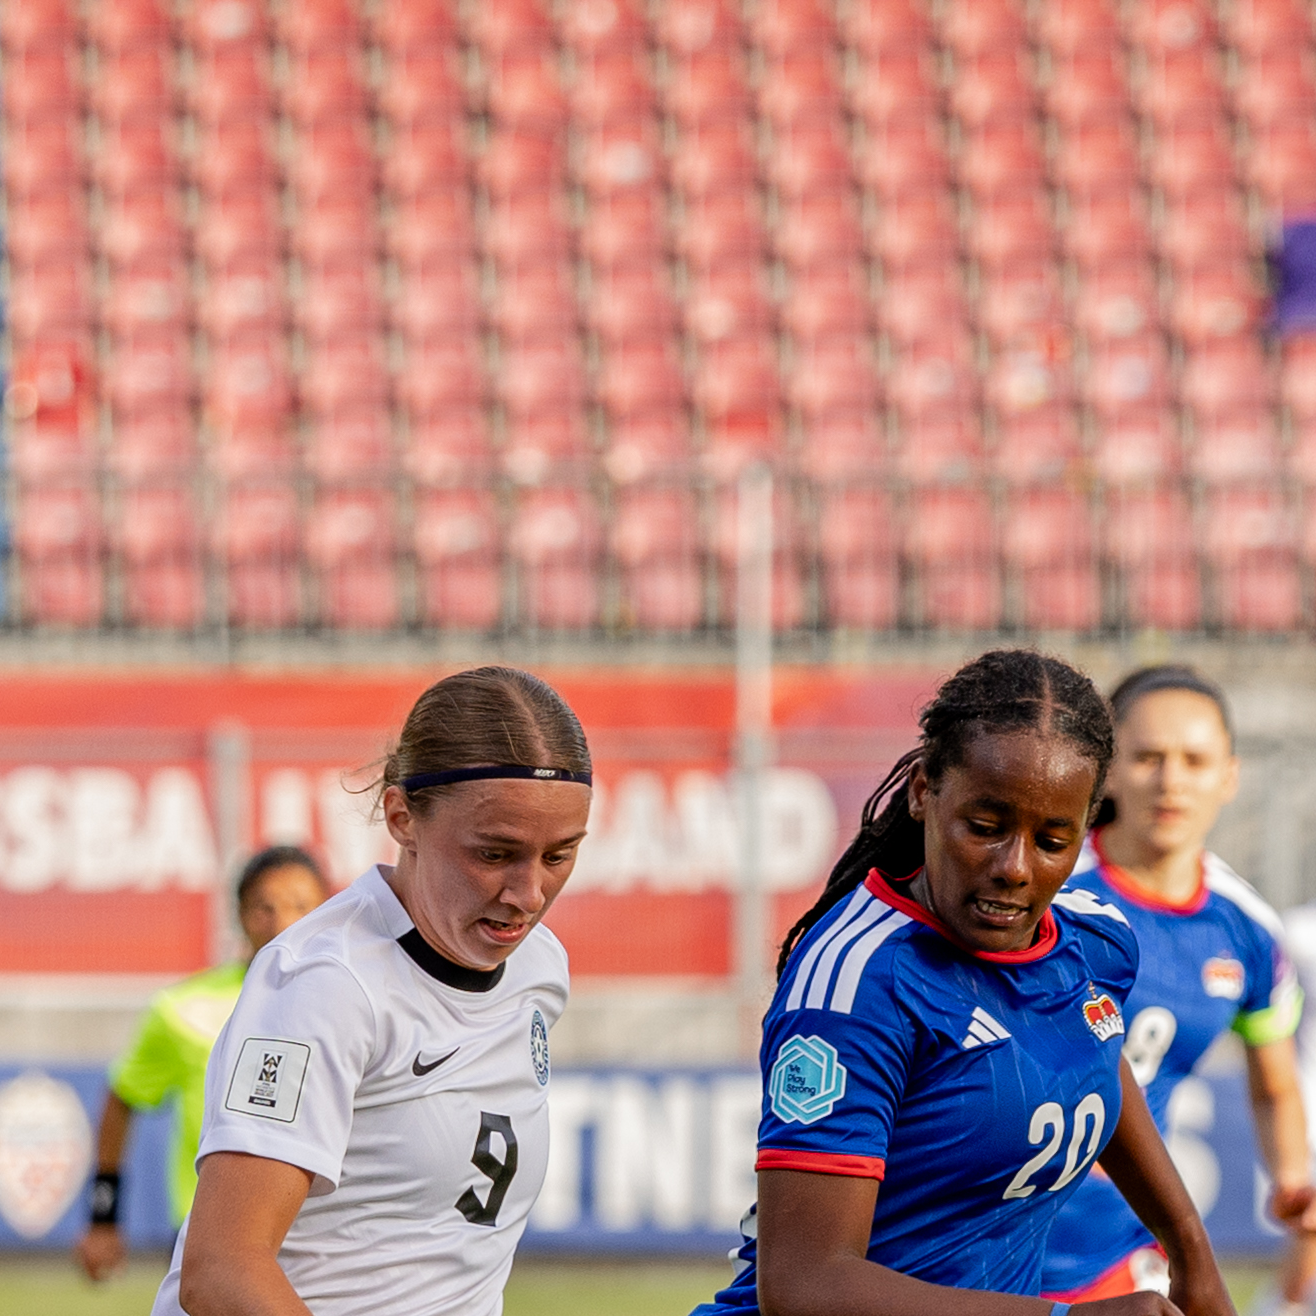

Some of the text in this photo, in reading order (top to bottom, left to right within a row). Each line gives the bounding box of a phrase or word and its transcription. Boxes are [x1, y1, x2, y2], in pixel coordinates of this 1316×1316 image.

[786, 1083, 817, 1097] Strong
[787, 1073, 806, 1086] Play
[453, 1110, 519, 1228] 9
[1002, 1092, 1106, 1200] 20
